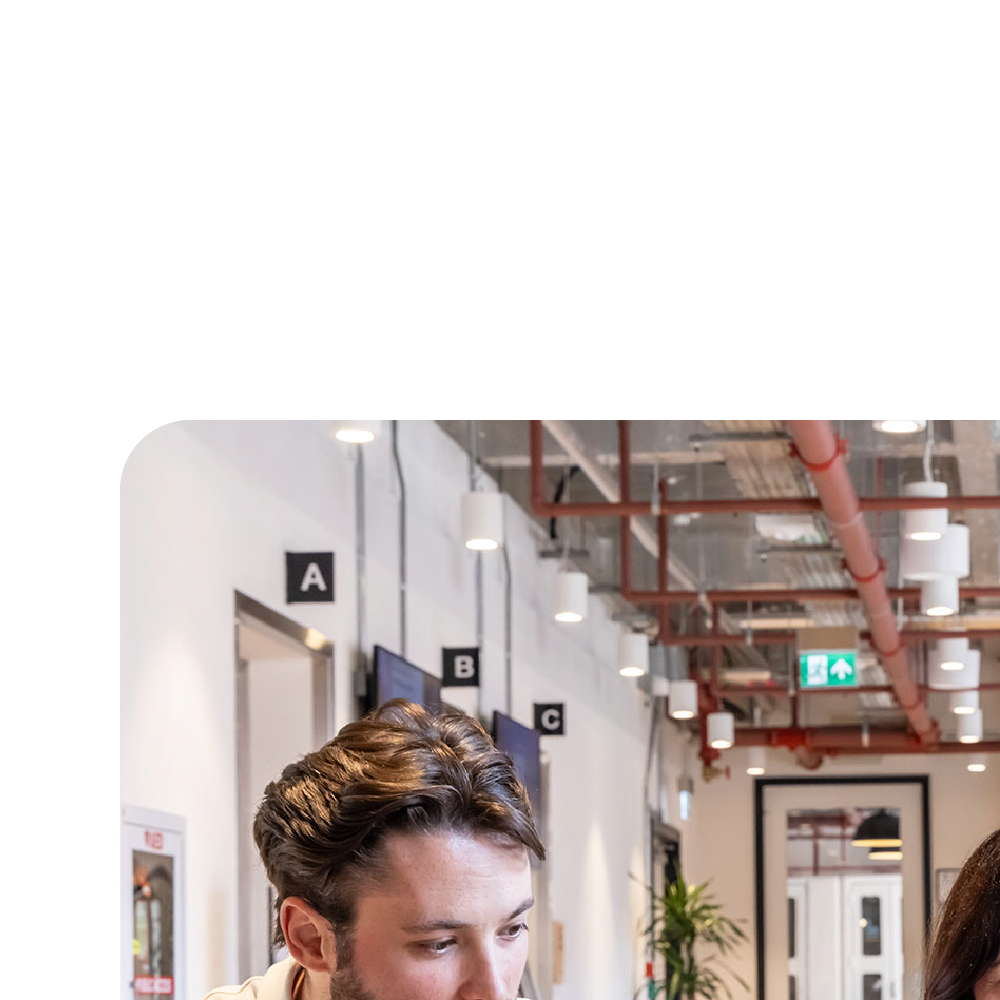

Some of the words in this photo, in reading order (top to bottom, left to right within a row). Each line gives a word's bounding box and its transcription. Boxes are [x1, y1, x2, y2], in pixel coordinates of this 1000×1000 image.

[300, 562, 327, 591] A
[454, 655, 475, 678] B
[541, 709, 560, 730] C
